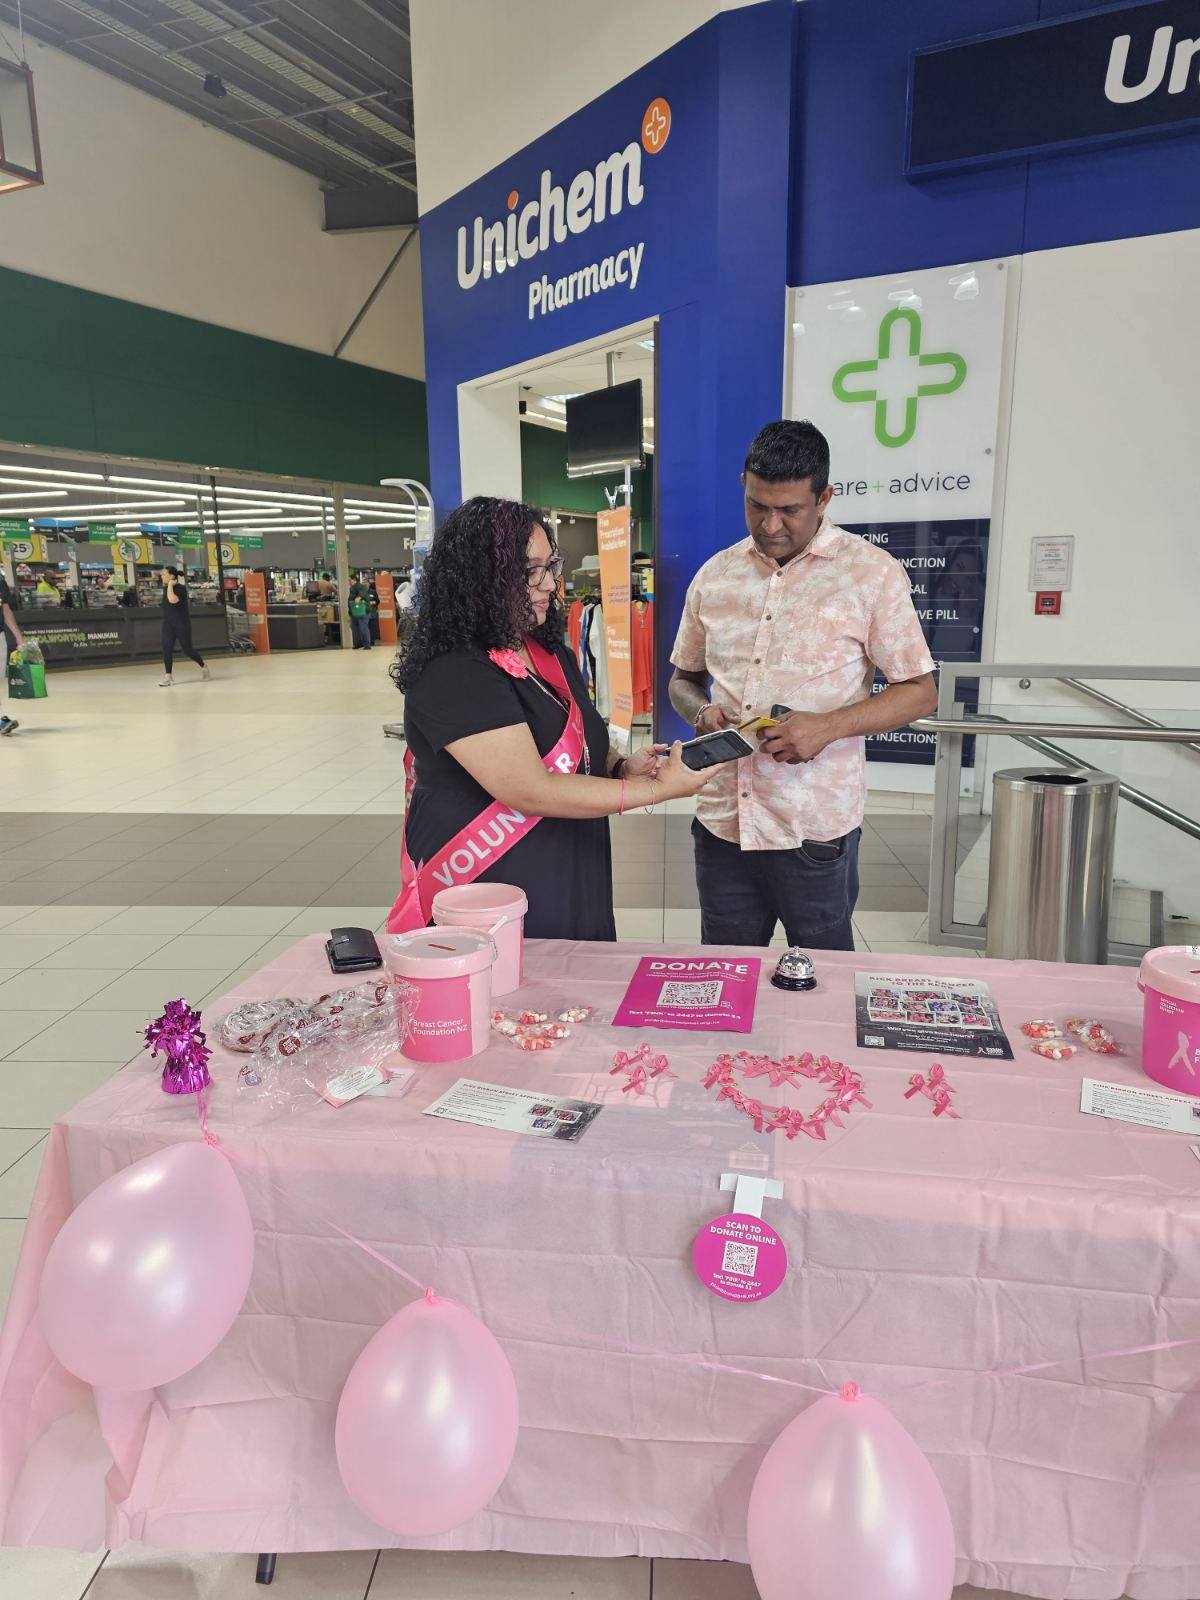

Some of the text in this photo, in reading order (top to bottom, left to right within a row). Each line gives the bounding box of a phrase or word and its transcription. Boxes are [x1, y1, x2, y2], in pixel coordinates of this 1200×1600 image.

[457, 142, 644, 289] Unichem
[528, 242, 645, 320] Pharmacy
[831, 480, 868, 497] are
[889, 471, 971, 494] advice
[860, 533, 889, 544] CING
[898, 557, 946, 569] NCTION
[909, 584, 928, 595] SAL
[935, 610, 960, 620] PILL
[876, 732, 938, 745] INJECTIONS
[650, 961, 749, 975] DONATE
[413, 1018, 464, 1028] Breast Cancer
[413, 1023, 468, 1036] Foundation NZ
[726, 1220, 762, 1234] SCAN TO
[710, 1225, 777, 1246] DONATE ONLINE
